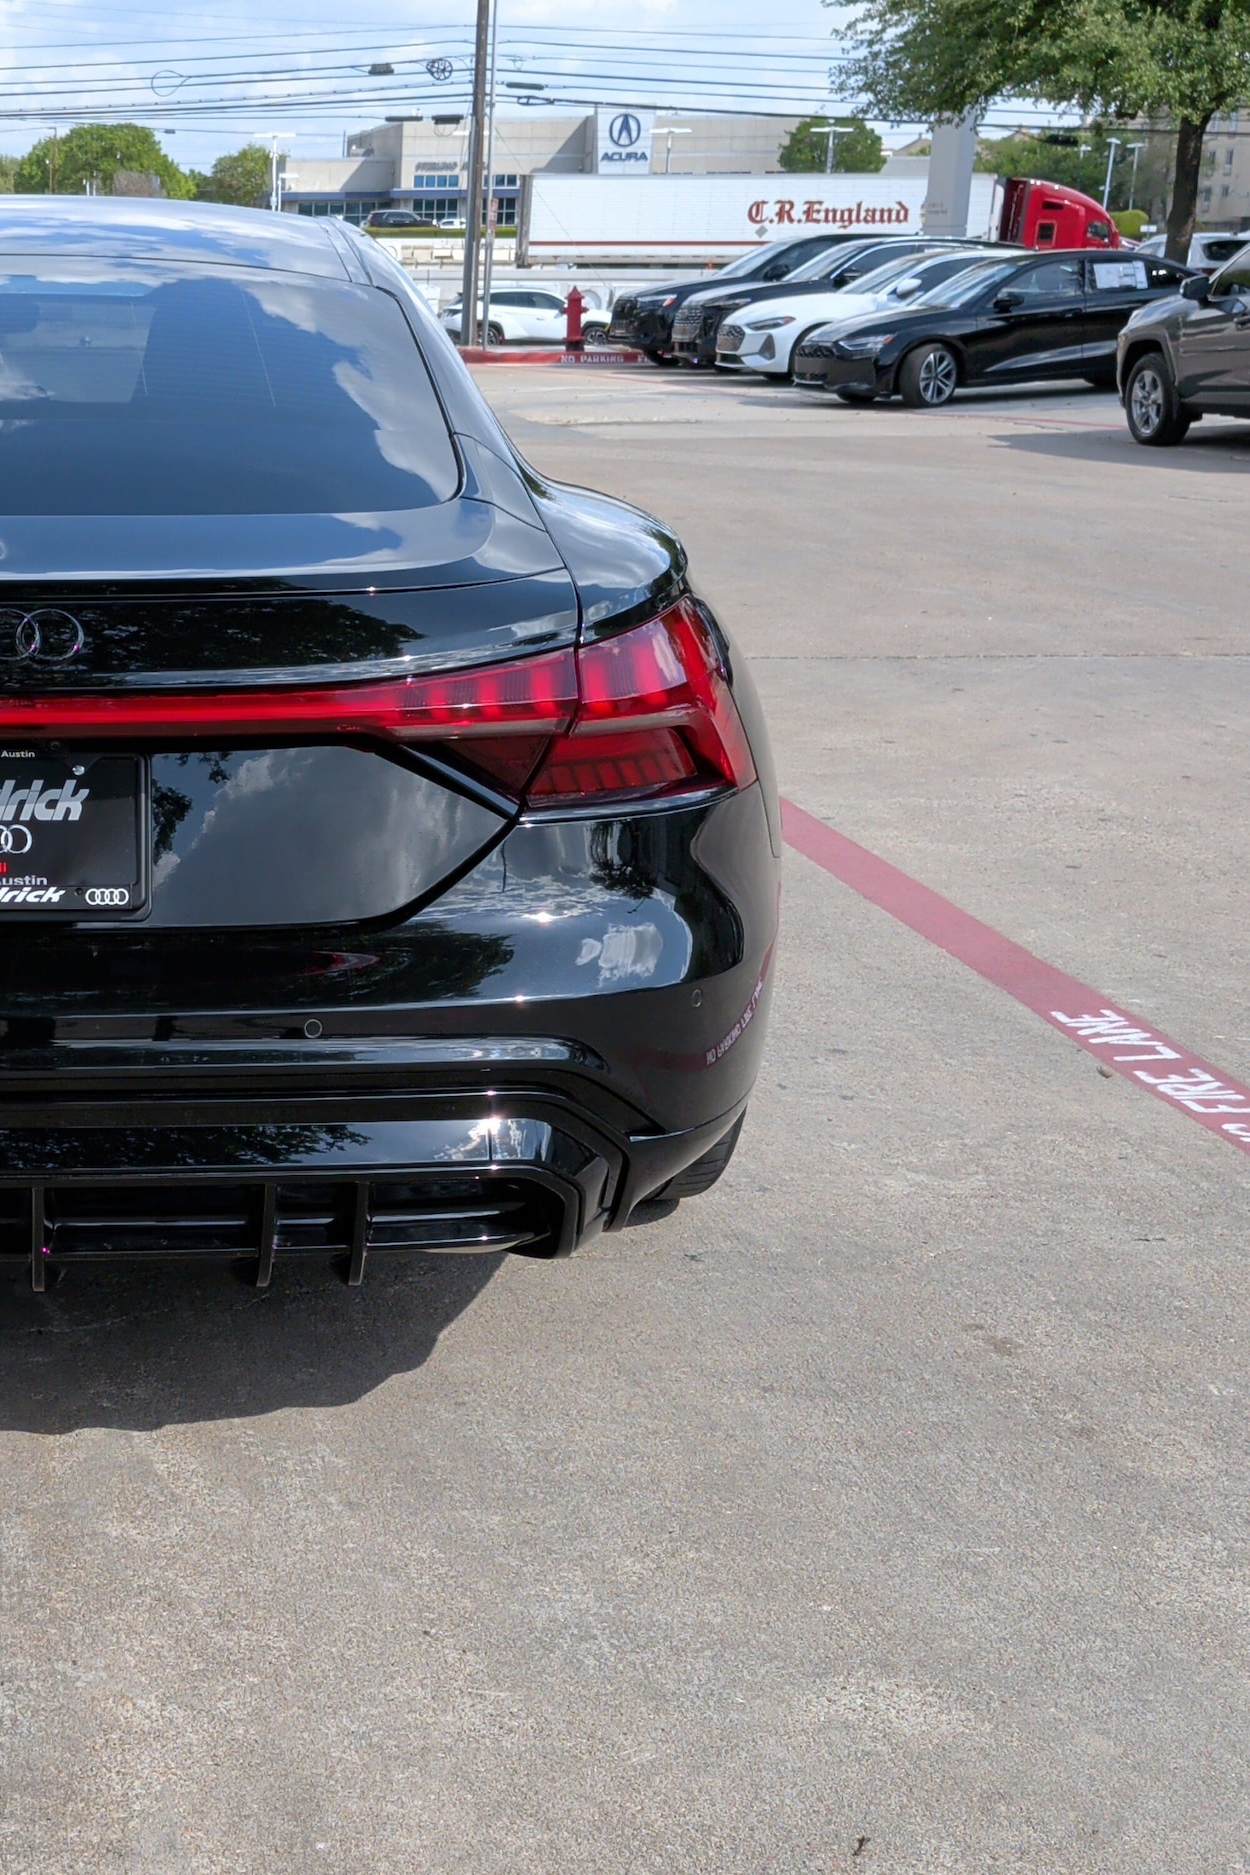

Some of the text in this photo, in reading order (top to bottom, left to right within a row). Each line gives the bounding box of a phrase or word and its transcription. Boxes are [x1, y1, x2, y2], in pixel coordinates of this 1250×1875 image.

[600, 151, 649, 162] ACURA
[561, 355, 575, 364] NO
[581, 355, 625, 364] PARKING
[0, 750, 36, 758] Austin
[1050, 1009, 1250, 1114] FIRE LANE
